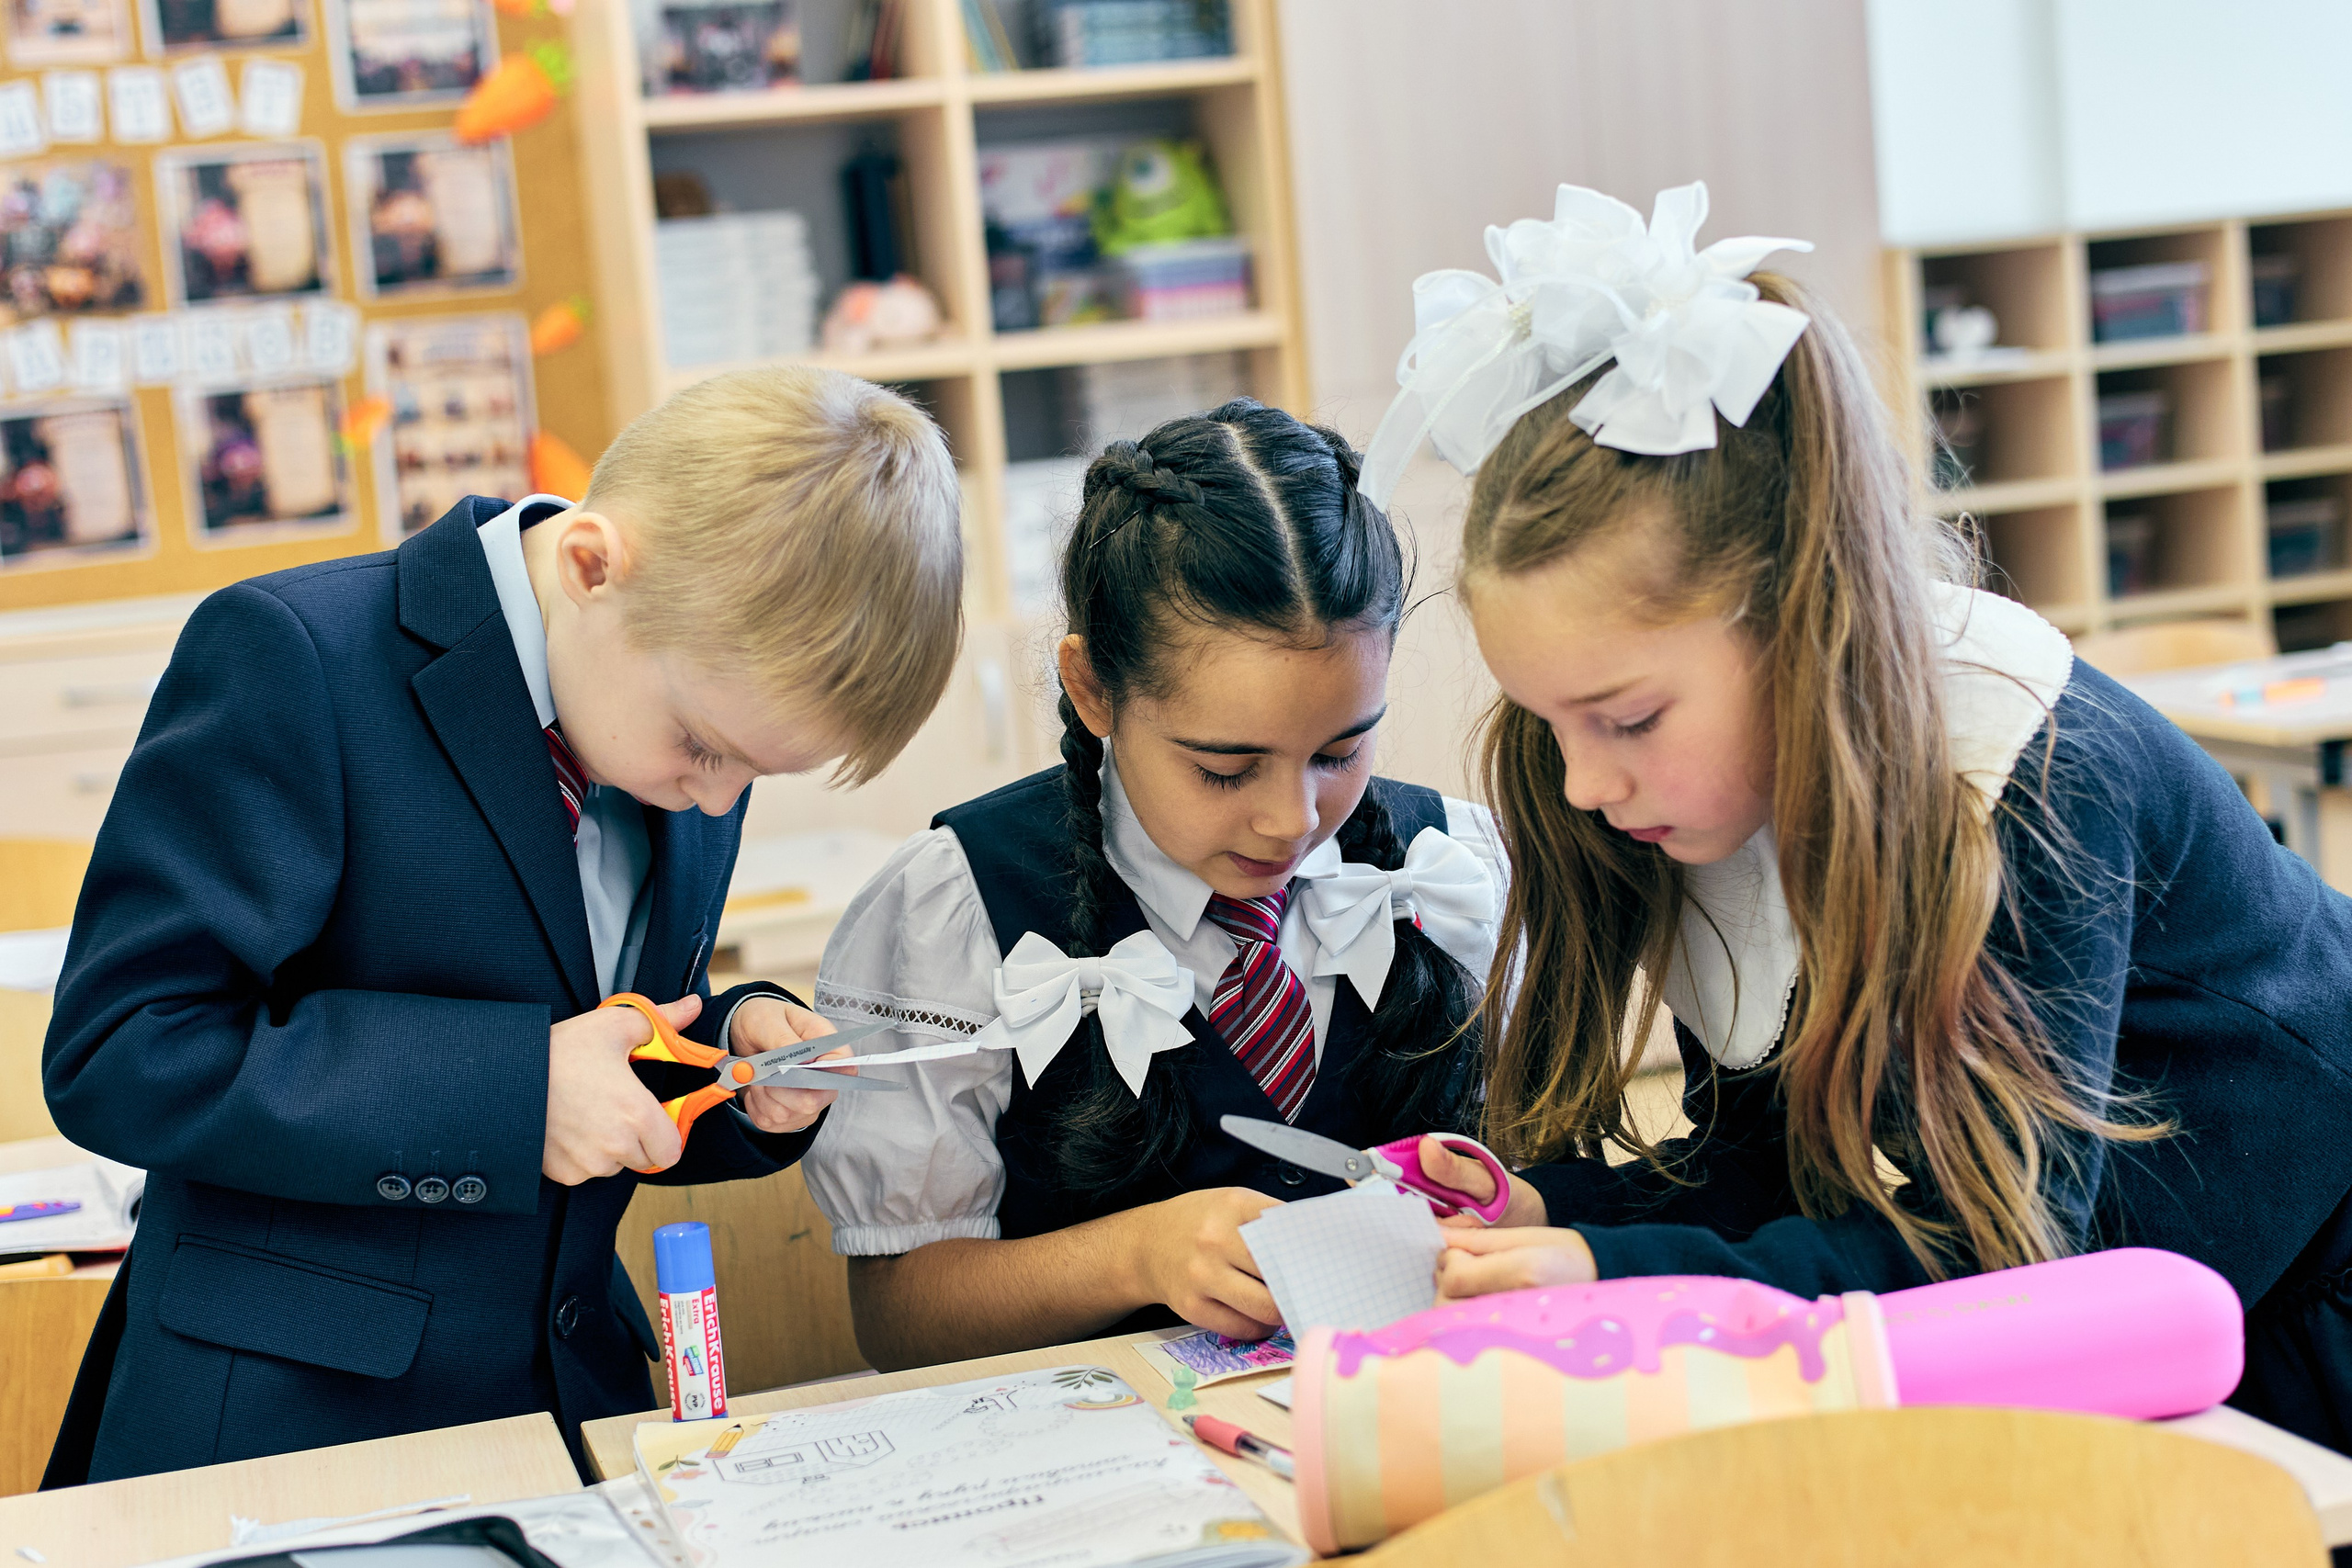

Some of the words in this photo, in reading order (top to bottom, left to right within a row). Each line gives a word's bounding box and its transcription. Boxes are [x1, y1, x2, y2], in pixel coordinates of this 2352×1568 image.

[692, 1298, 700, 1325] Extra
[704, 1292, 723, 1410] ErichKrause
[918, 1478, 989, 1501] руку
